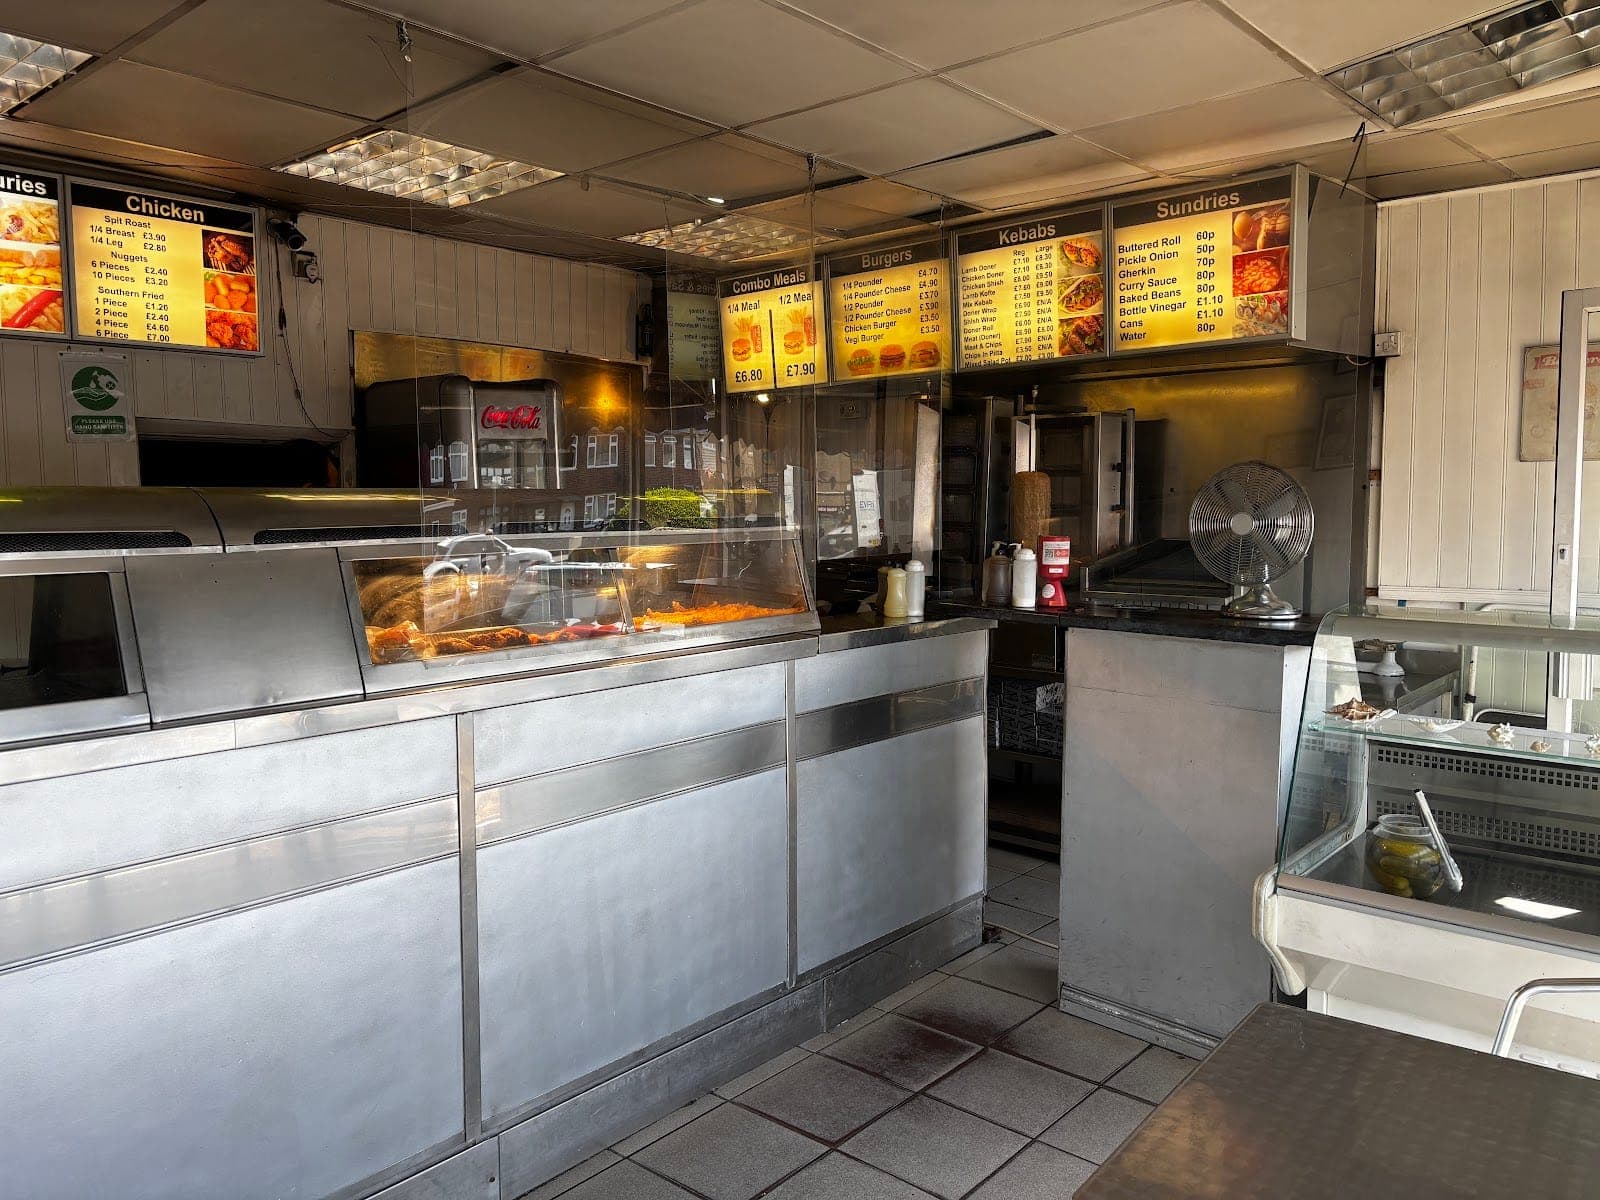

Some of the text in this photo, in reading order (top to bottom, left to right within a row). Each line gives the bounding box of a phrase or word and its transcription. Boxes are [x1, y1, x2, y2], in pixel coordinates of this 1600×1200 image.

[126, 195, 204, 223] Chicken
[1157, 191, 1240, 218] Sundries
[104, 216, 151, 228] Spit Roast
[106, 227, 135, 237] Breast
[143, 232, 166, 241] £3.90
[999, 224, 1056, 245] Kebabs
[90, 236, 103, 244] 1/4
[106, 238, 123, 248] Leg
[1118, 231, 1215, 254] Buttered Roll 60p
[111, 251, 148, 262] Nuggets
[862, 250, 912, 268] Burgers
[1118, 244, 1215, 266] Pickle Onion 50p
[91, 260, 167, 275] 6 Pieces £2.40
[961, 266, 977, 274] Lamb
[1119, 257, 1215, 279] Gherkin 70p
[106, 273, 135, 283] Pieces
[145, 277, 168, 286] £3.20
[733, 270, 806, 293] Combo Meals
[854, 278, 883, 288] Pounder
[919, 268, 937, 277] £4.70
[987, 271, 1004, 279] Doner
[1119, 270, 1215, 292] Curry Sauce 80p
[98, 286, 164, 300] Southern Fried
[843, 279, 938, 301] 1/4 Pounder Cheese £4.90
[1119, 284, 1215, 304] Baked Beans 80p
[103, 298, 128, 307] Piece
[146, 303, 168, 311] £1.20
[728, 304, 738, 313] 1/4
[742, 300, 760, 312] Meal
[779, 295, 791, 305] 1/2
[855, 300, 883, 309] Pounder
[1119, 295, 1224, 316] Bottle Vinegar £1.10
[103, 309, 128, 318] Piece
[146, 313, 168, 321] £2.40
[856, 311, 883, 320] Pounder
[886, 307, 912, 316] Cheese
[1120, 308, 1224, 329] Cans £1.10
[104, 320, 128, 328] Piece
[844, 323, 871, 333] Chicken
[874, 320, 896, 329] Burger
[105, 330, 128, 339] Piece
[845, 325, 939, 344] Vegi Burger £3.50
[979, 333, 1000, 341] (Doner)
[1120, 323, 1215, 341] Water 80p
[736, 369, 762, 382] £6.80
[787, 363, 815, 376] £7.90
